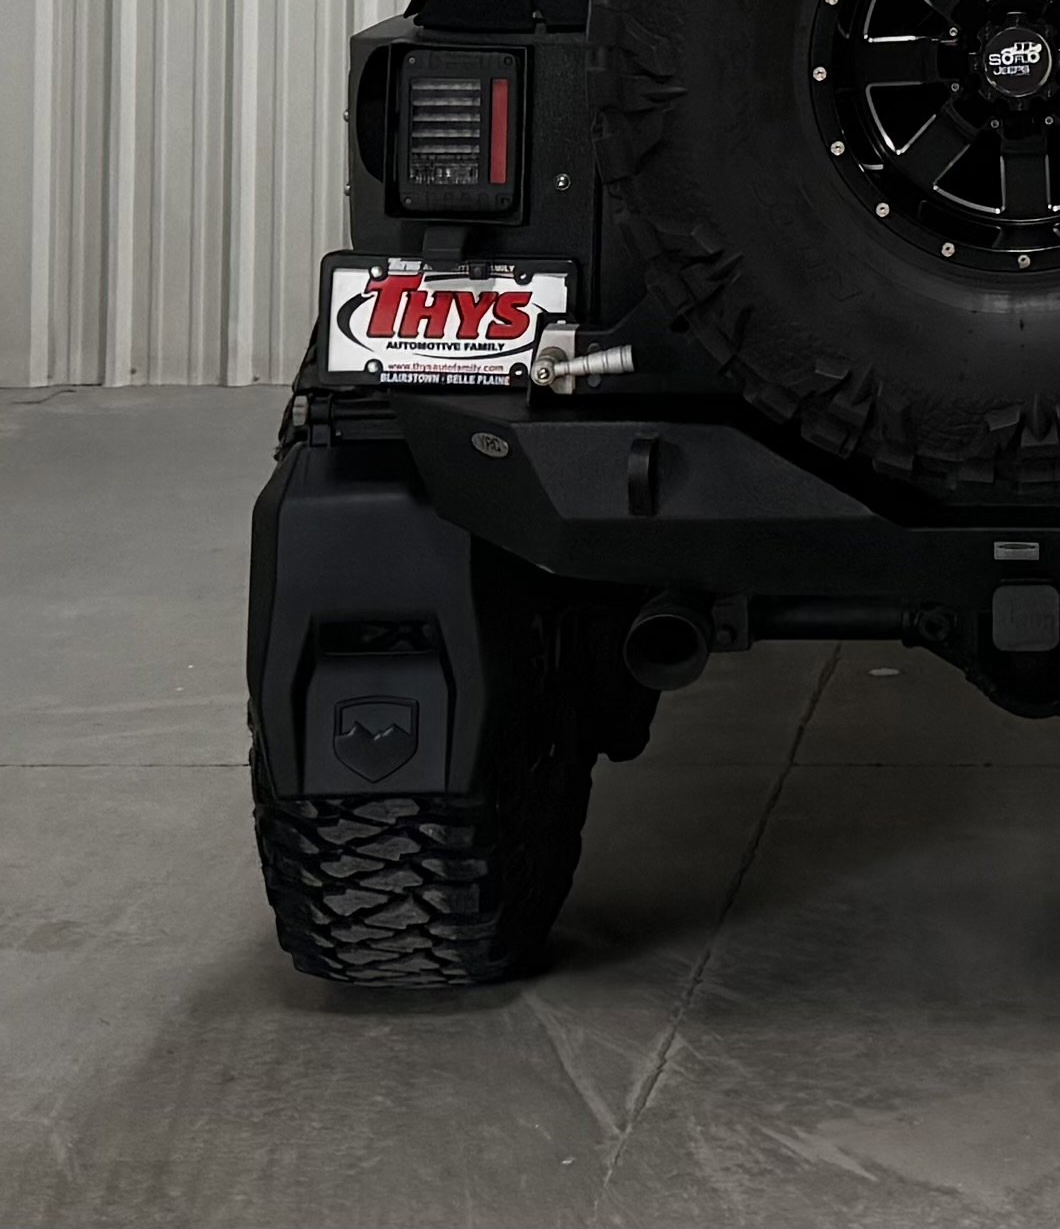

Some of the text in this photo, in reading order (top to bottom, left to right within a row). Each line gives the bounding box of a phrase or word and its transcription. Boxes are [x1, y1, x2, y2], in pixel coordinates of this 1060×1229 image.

[364, 273, 533, 340] THYS
[386, 341, 505, 352] AUTOMOTIVE FAMILY
[380, 372, 510, 386] BLAIRSTOWN BELLE PLAINE
